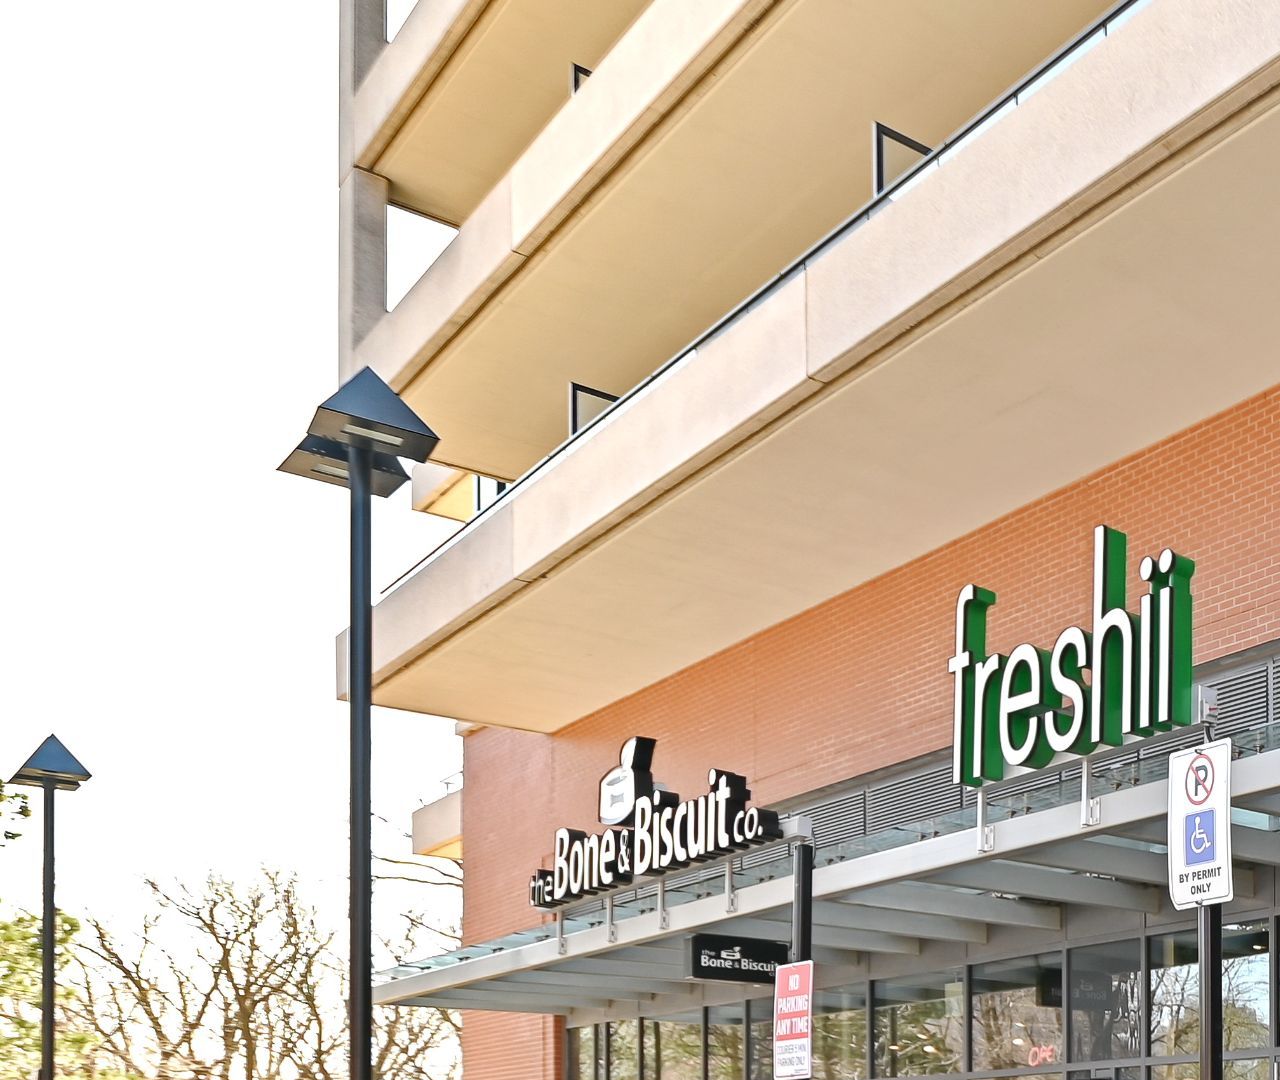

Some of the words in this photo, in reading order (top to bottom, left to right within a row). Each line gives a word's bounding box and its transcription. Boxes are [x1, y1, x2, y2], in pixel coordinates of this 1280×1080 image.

[947, 524, 1184, 784] freshii
[554, 827, 616, 900] Bone
[617, 828, 630, 874] &
[634, 768, 731, 875] Biscuit
[1179, 873, 1190, 884] BY
[1191, 867, 1222, 881] PERMIT
[1190, 882, 1211, 895] ONLY
[701, 954, 733, 969] Bone
[788, 974, 800, 991] NO
[777, 994, 809, 1014] PARKING
[776, 1018, 792, 1036] ANY
[792, 1016, 808, 1034] TIME
